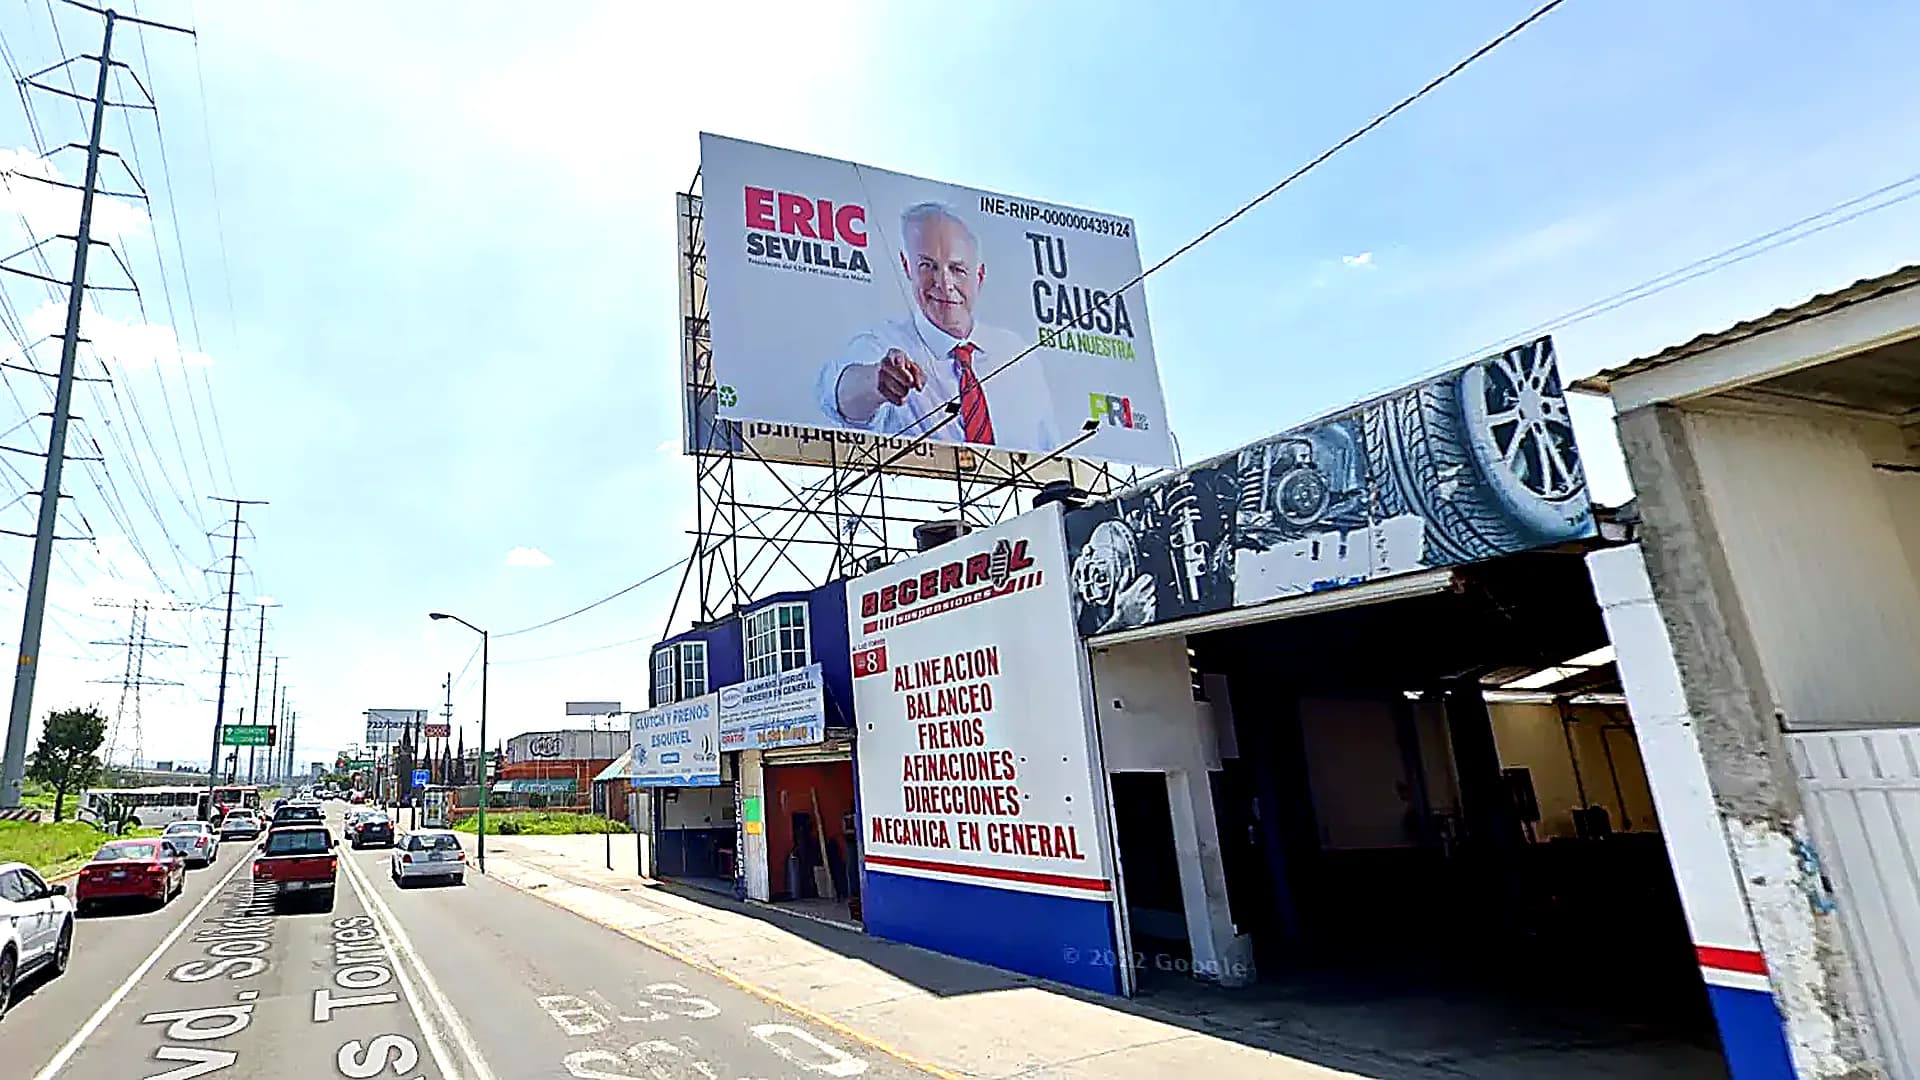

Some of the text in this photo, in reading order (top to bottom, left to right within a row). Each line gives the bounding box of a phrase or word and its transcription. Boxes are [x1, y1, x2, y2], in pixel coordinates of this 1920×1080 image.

[745, 186, 868, 248] ERIC
[979, 196, 1131, 238] INE-RNP-000000439124
[747, 232, 872, 274] SEVILLA
[1026, 231, 1068, 280] TU
[1033, 279, 1135, 338] CAUSA
[1038, 326, 1136, 362] ES LA NUESTRA
[1089, 392, 1133, 429] PRI
[896, 589, 993, 624] suspensiones
[783, 680, 816, 695] GENERAL
[893, 646, 999, 692] ALINEACION
[635, 711, 666, 730] CLUTCH
[673, 703, 710, 724] FRENOS
[906, 683, 993, 721] BALANCEO
[651, 730, 692, 748] ESQUIVEL
[918, 718, 985, 750] FRENOS
[903, 751, 1016, 782] AFINACIONES
[904, 785, 1020, 817] DIRECCIONES
[872, 817, 1085, 860] MECANICA EN GENERAL
